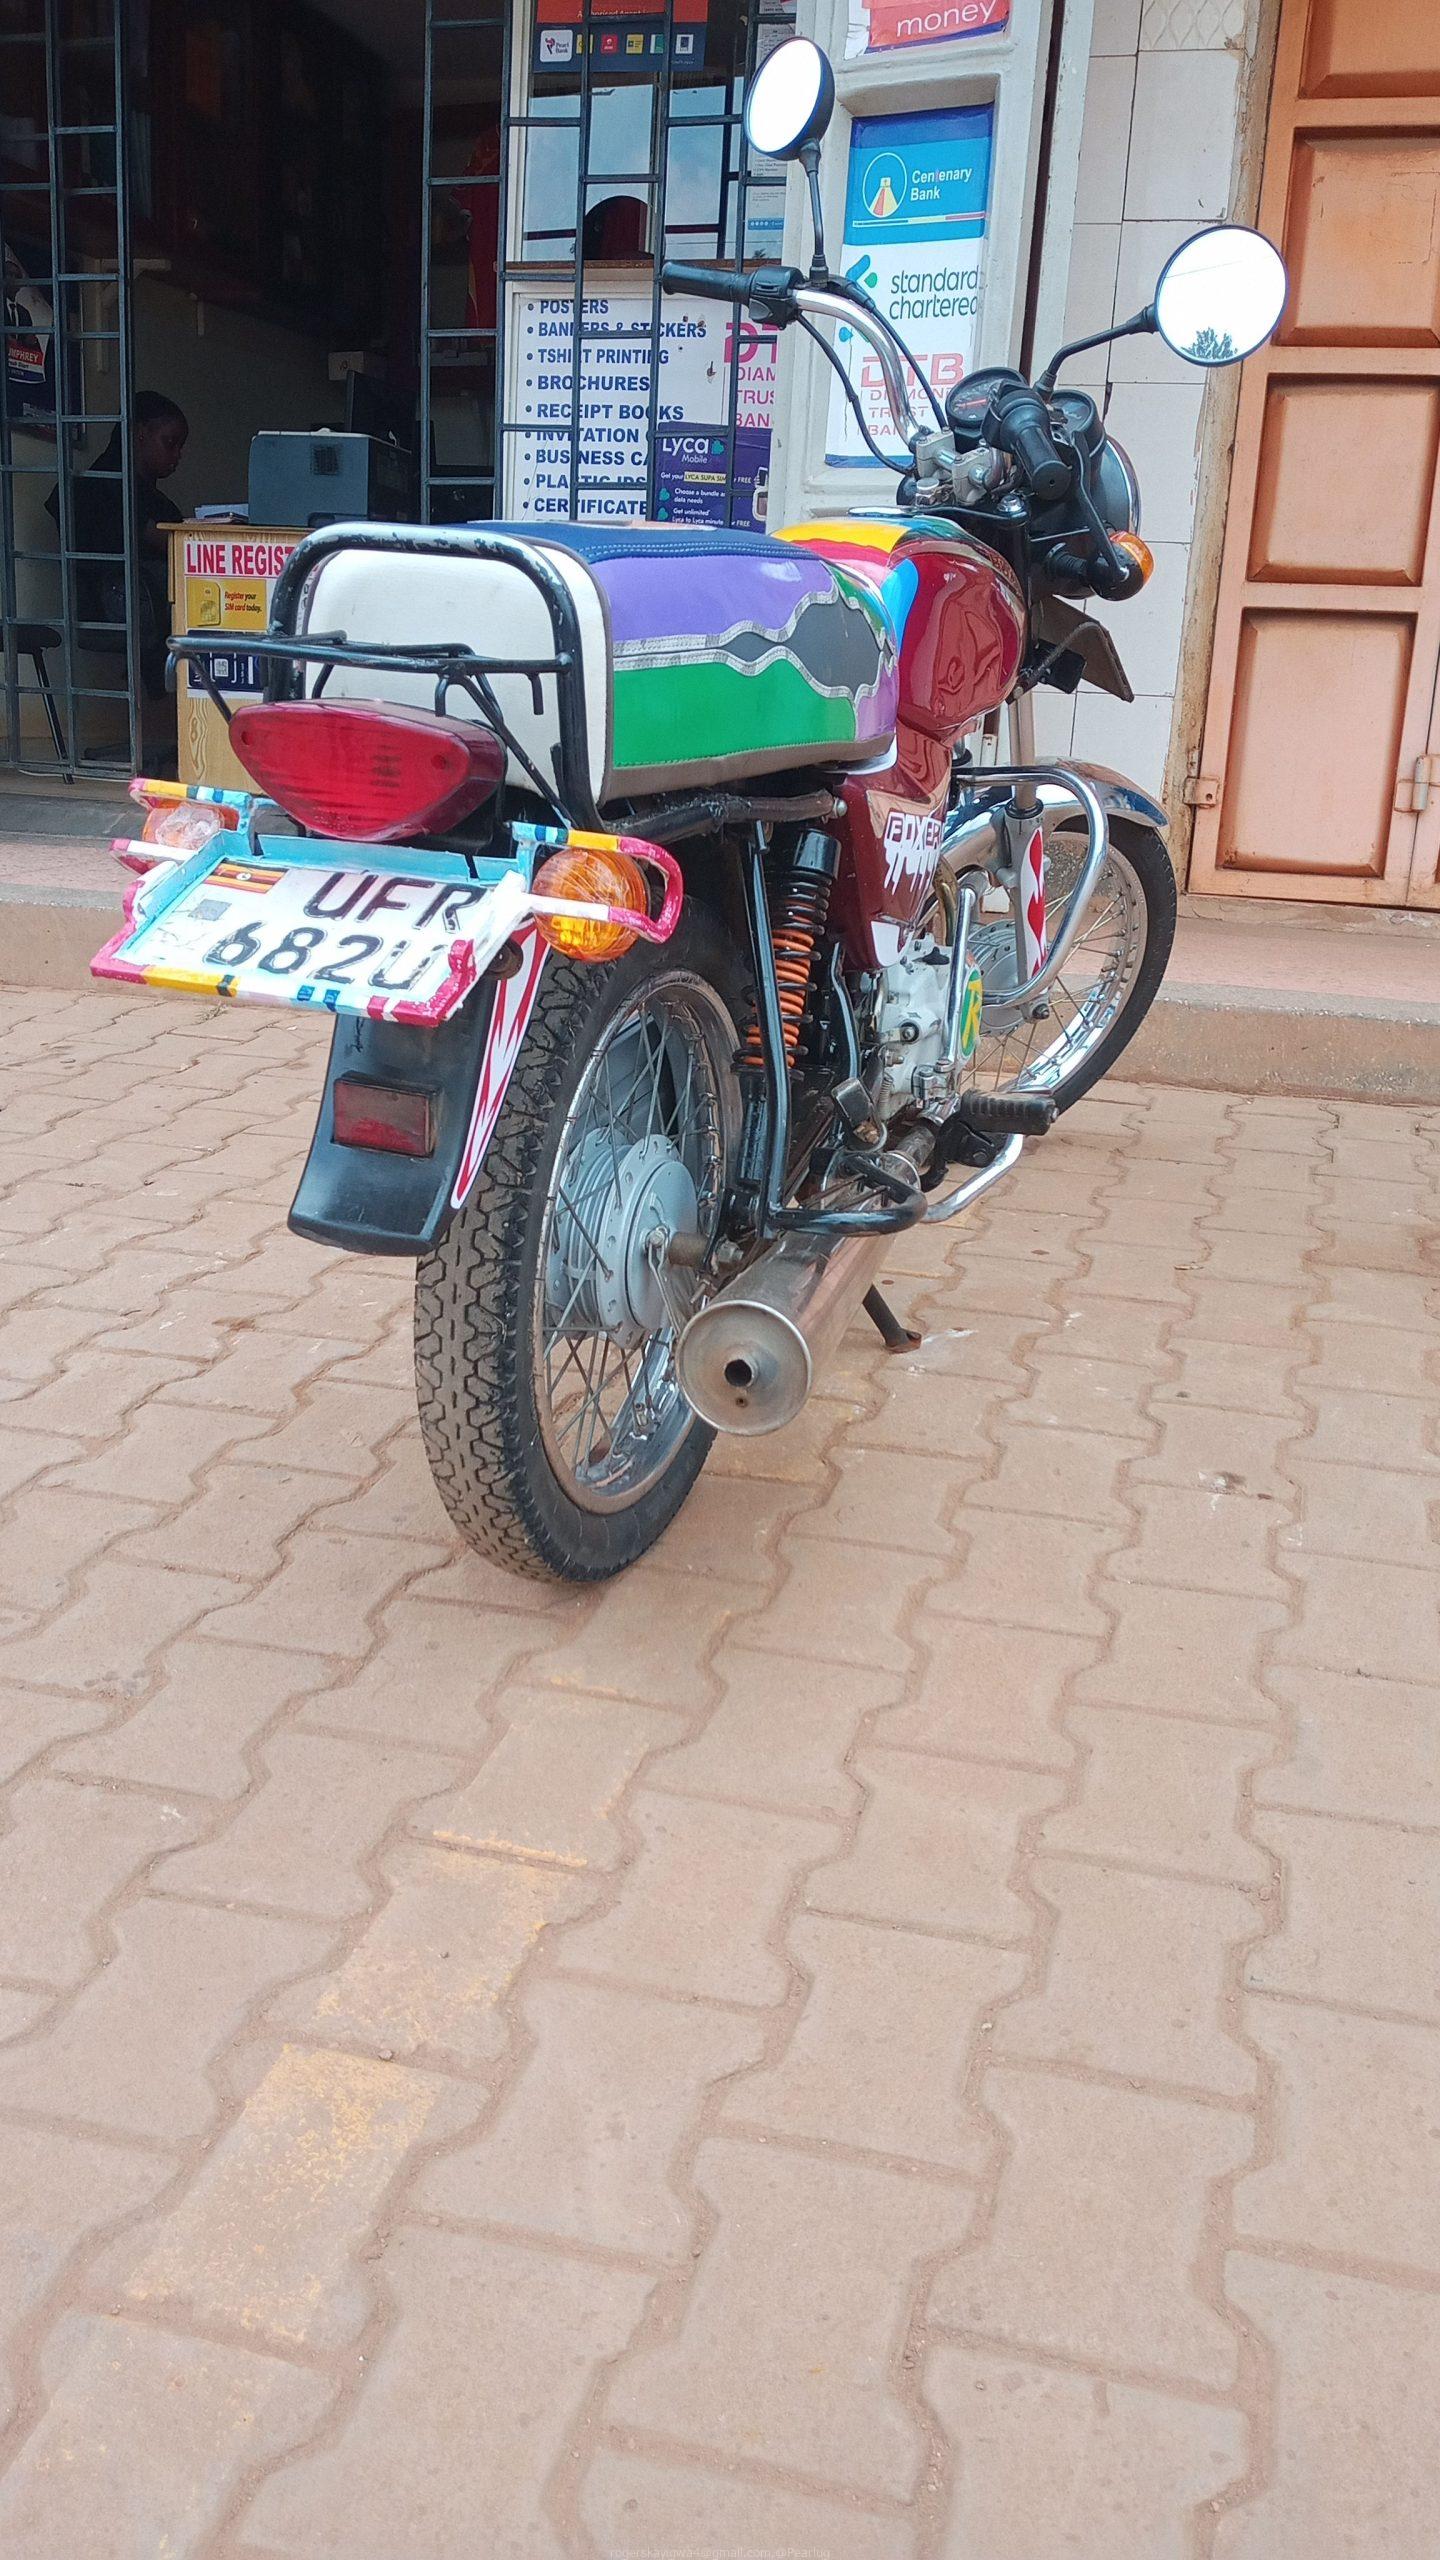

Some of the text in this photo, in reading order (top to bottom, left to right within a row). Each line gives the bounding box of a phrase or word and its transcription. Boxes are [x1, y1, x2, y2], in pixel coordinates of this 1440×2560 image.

[896, 0, 997, 37] money
[912, 168, 972, 184] Centenary
[910, 186, 940, 201] Bank
[890, 264, 979, 294] standard
[540, 300, 609, 314] POSERS
[631, 323, 706, 338] STCKERS
[538, 349, 592, 363] TSHIT
[538, 376, 650, 391] BROCHURES
[619, 405, 684, 420] BOKS
[869, 406, 929, 419] TRST
[536, 427, 639, 443] INVIATION
[536, 450, 624, 465] BUSNESS
[681, 454, 708, 464] Mobile
[536, 474, 611, 489] PLATIC
[674, 488, 694, 496] Choose
[700, 489, 720, 497] bundle
[534, 498, 648, 515] CERIFICATE
[187, 544, 226, 574] LINE
[224, 591, 257, 601] Register your
[224, 602, 234, 611] SIM
[234, 603, 246, 611] card
[303, 871, 488, 933] UFR
[203, 921, 448, 992] 682U
